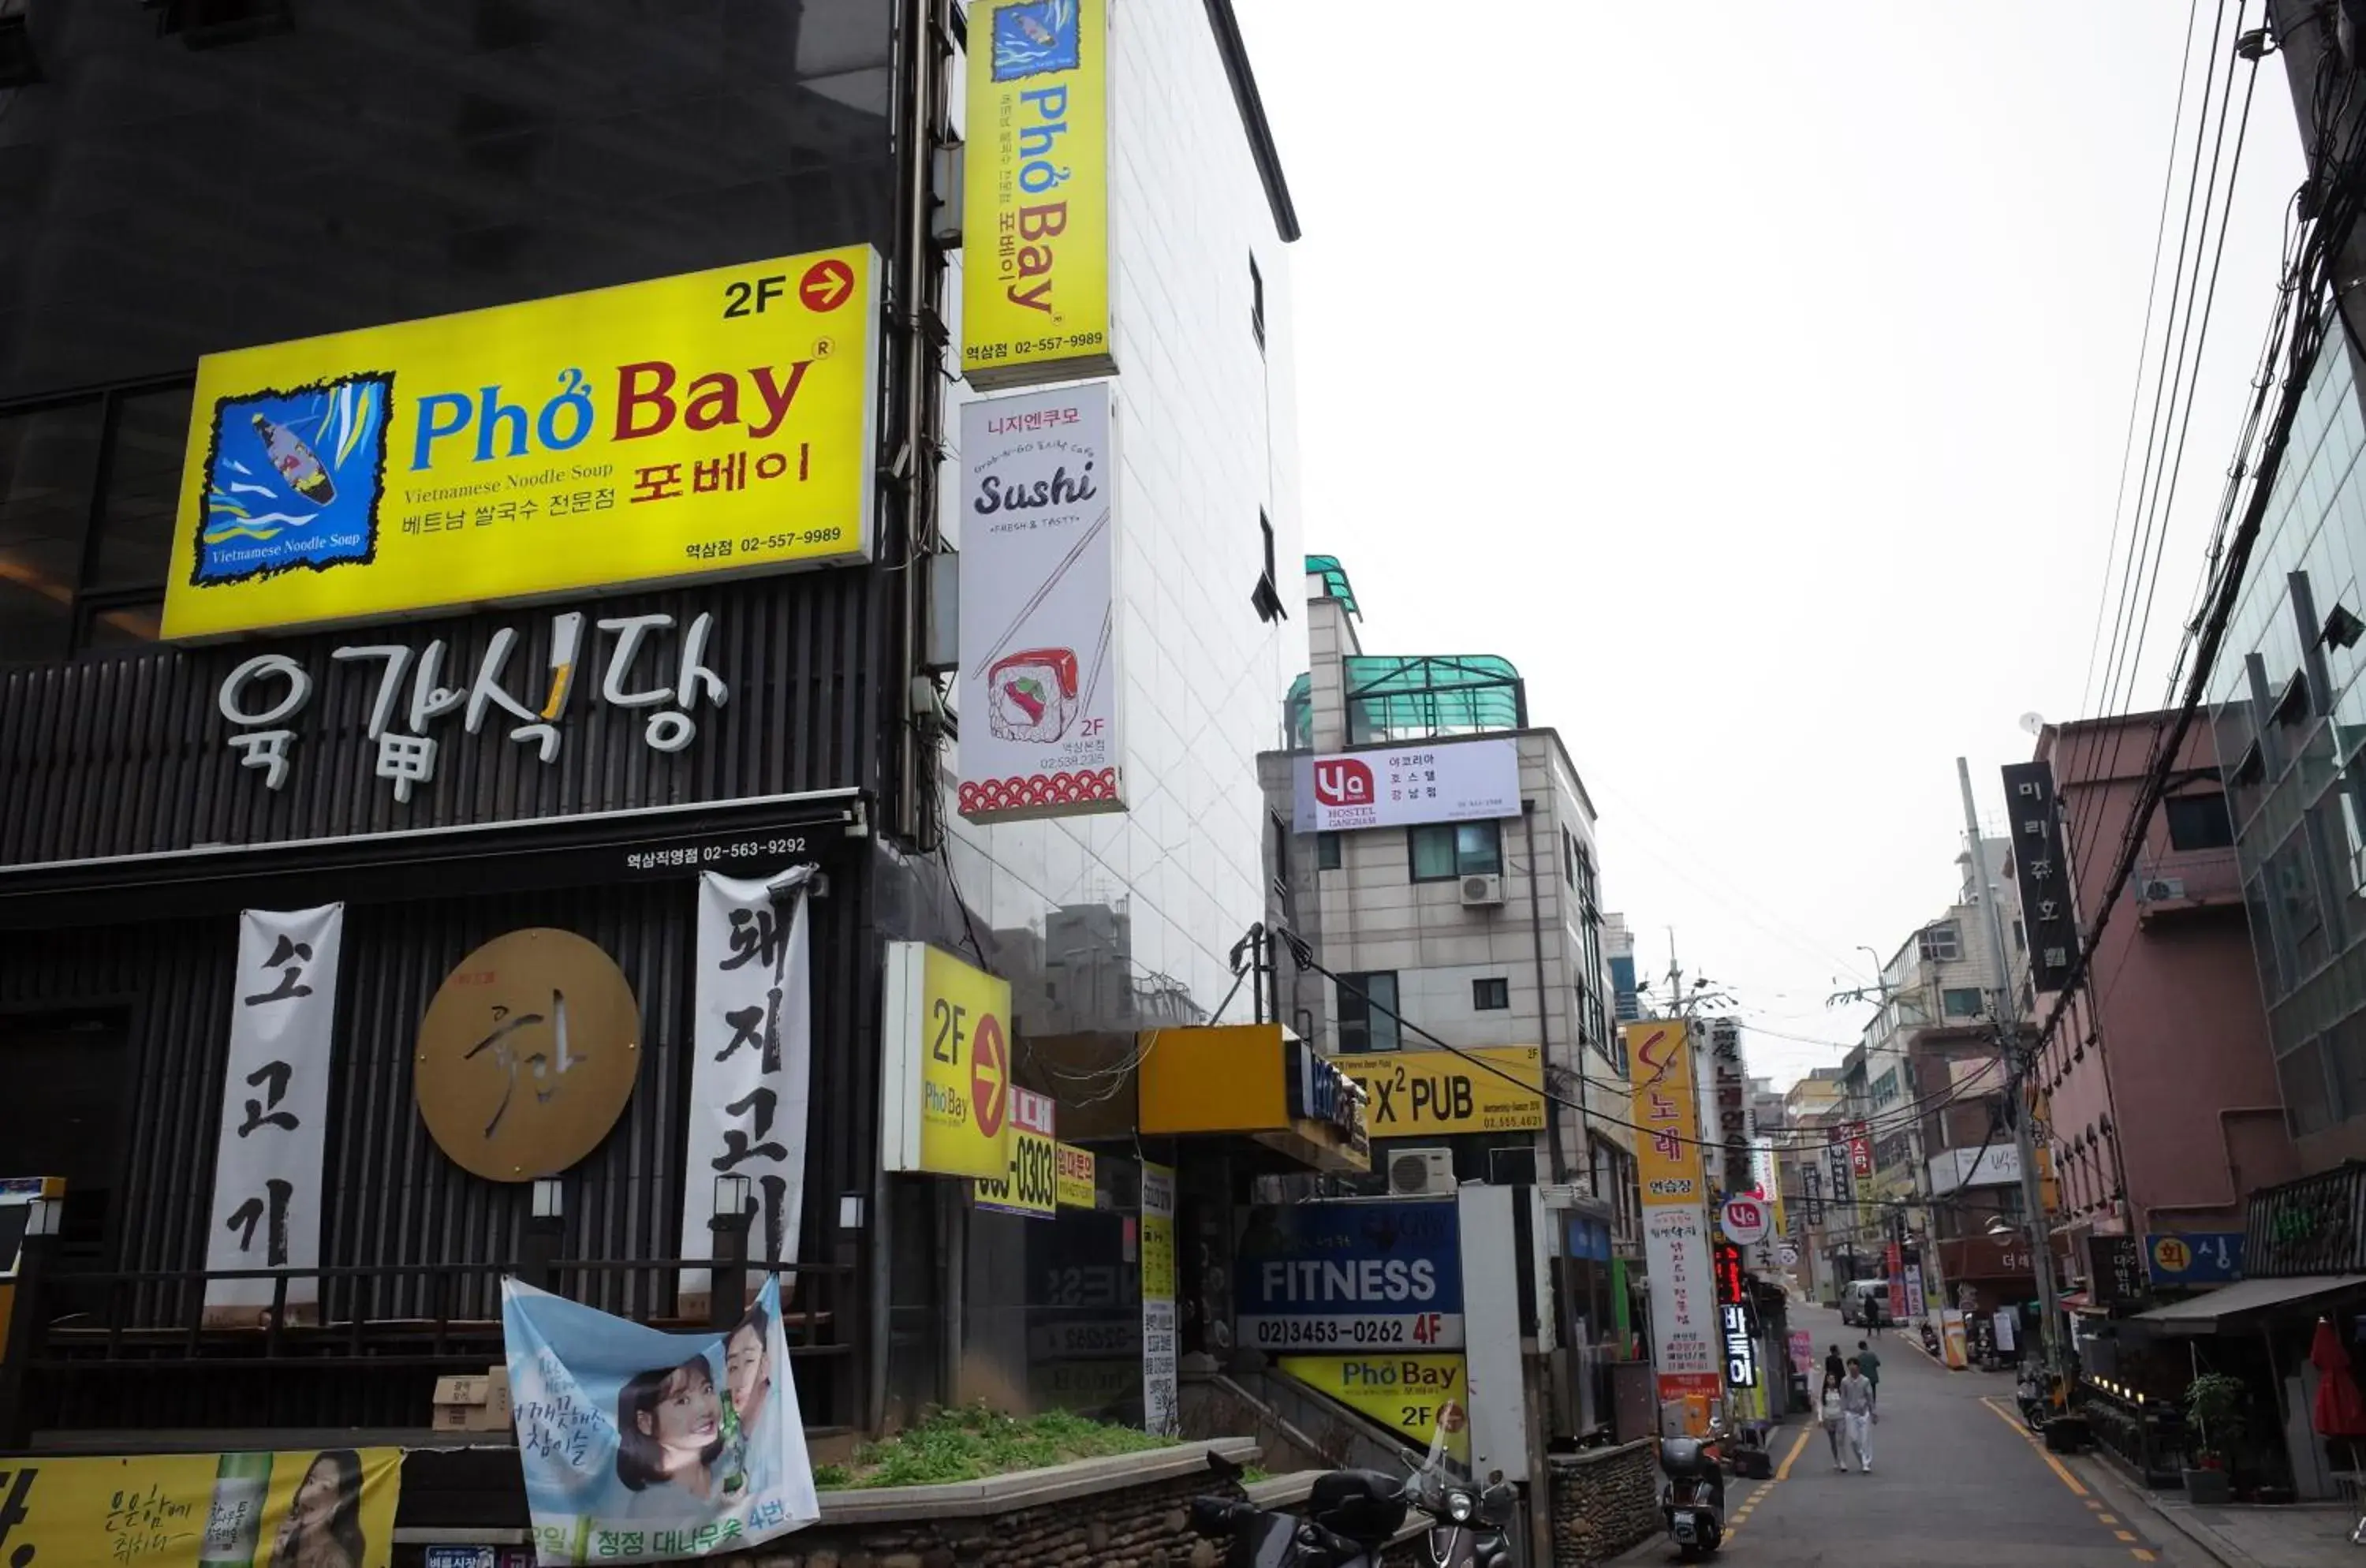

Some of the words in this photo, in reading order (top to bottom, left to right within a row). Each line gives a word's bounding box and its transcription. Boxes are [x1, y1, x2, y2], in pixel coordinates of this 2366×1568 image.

[998, 211, 1016, 282] 포베이
[1007, 202, 1068, 315] Bay
[724, 276, 786, 318] 2F
[966, 343, 1008, 360] 역삼점
[1015, 332, 1103, 354] 02-557-9989
[610, 360, 814, 441] Bay
[988, 408, 1081, 435] 니지엔쿠모
[404, 482, 501, 504] Vietnamese
[506, 470, 565, 489] Noodle
[571, 464, 613, 480] Soup
[629, 443, 809, 503] 포베이
[974, 461, 1097, 514] Sushi
[402, 508, 465, 535] 베트남
[475, 499, 539, 527] 쌀국수
[549, 488, 615, 517] 전문점
[212, 545, 282, 563] Vietnamese
[284, 536, 327, 554] Noodle
[330, 533, 360, 549] Soup
[686, 540, 732, 558] 역삼점
[741, 528, 841, 552] 02-557-9989
[1080, 719, 1104, 737] 2F
[1328, 807, 1376, 818] HOSTEL
[1328, 816, 1376, 828] GANGNAM
[627, 850, 698, 869] 역삼직영점
[703, 837, 805, 861] 02-563-9292
[933, 998, 966, 1065] 2F
[226, 933, 315, 1267] 소고기
[707, 907, 789, 1264] 돼지고기
[1412, 1075, 1473, 1122] PUB
[948, 1086, 968, 1123] Bay
[1650, 1092, 1682, 1162] 노래
[1058, 1148, 1092, 1181] 임대문의
[1650, 1179, 1691, 1195] 연습장
[2161, 1241, 2184, 1268] 회
[2198, 1236, 2246, 1270] 싱
[1262, 1259, 1437, 1301] FITNESS
[1258, 1320, 1402, 1342] 02)3453-0262
[1413, 1313, 1441, 1344] 4F
[1725, 1308, 1753, 1386] 바둑이
[1402, 1361, 1456, 1389] Bay
[1402, 1406, 1431, 1426] 2F
[527, 1423, 588, 1466] 참이슬
[597, 1529, 645, 1557] 청정
